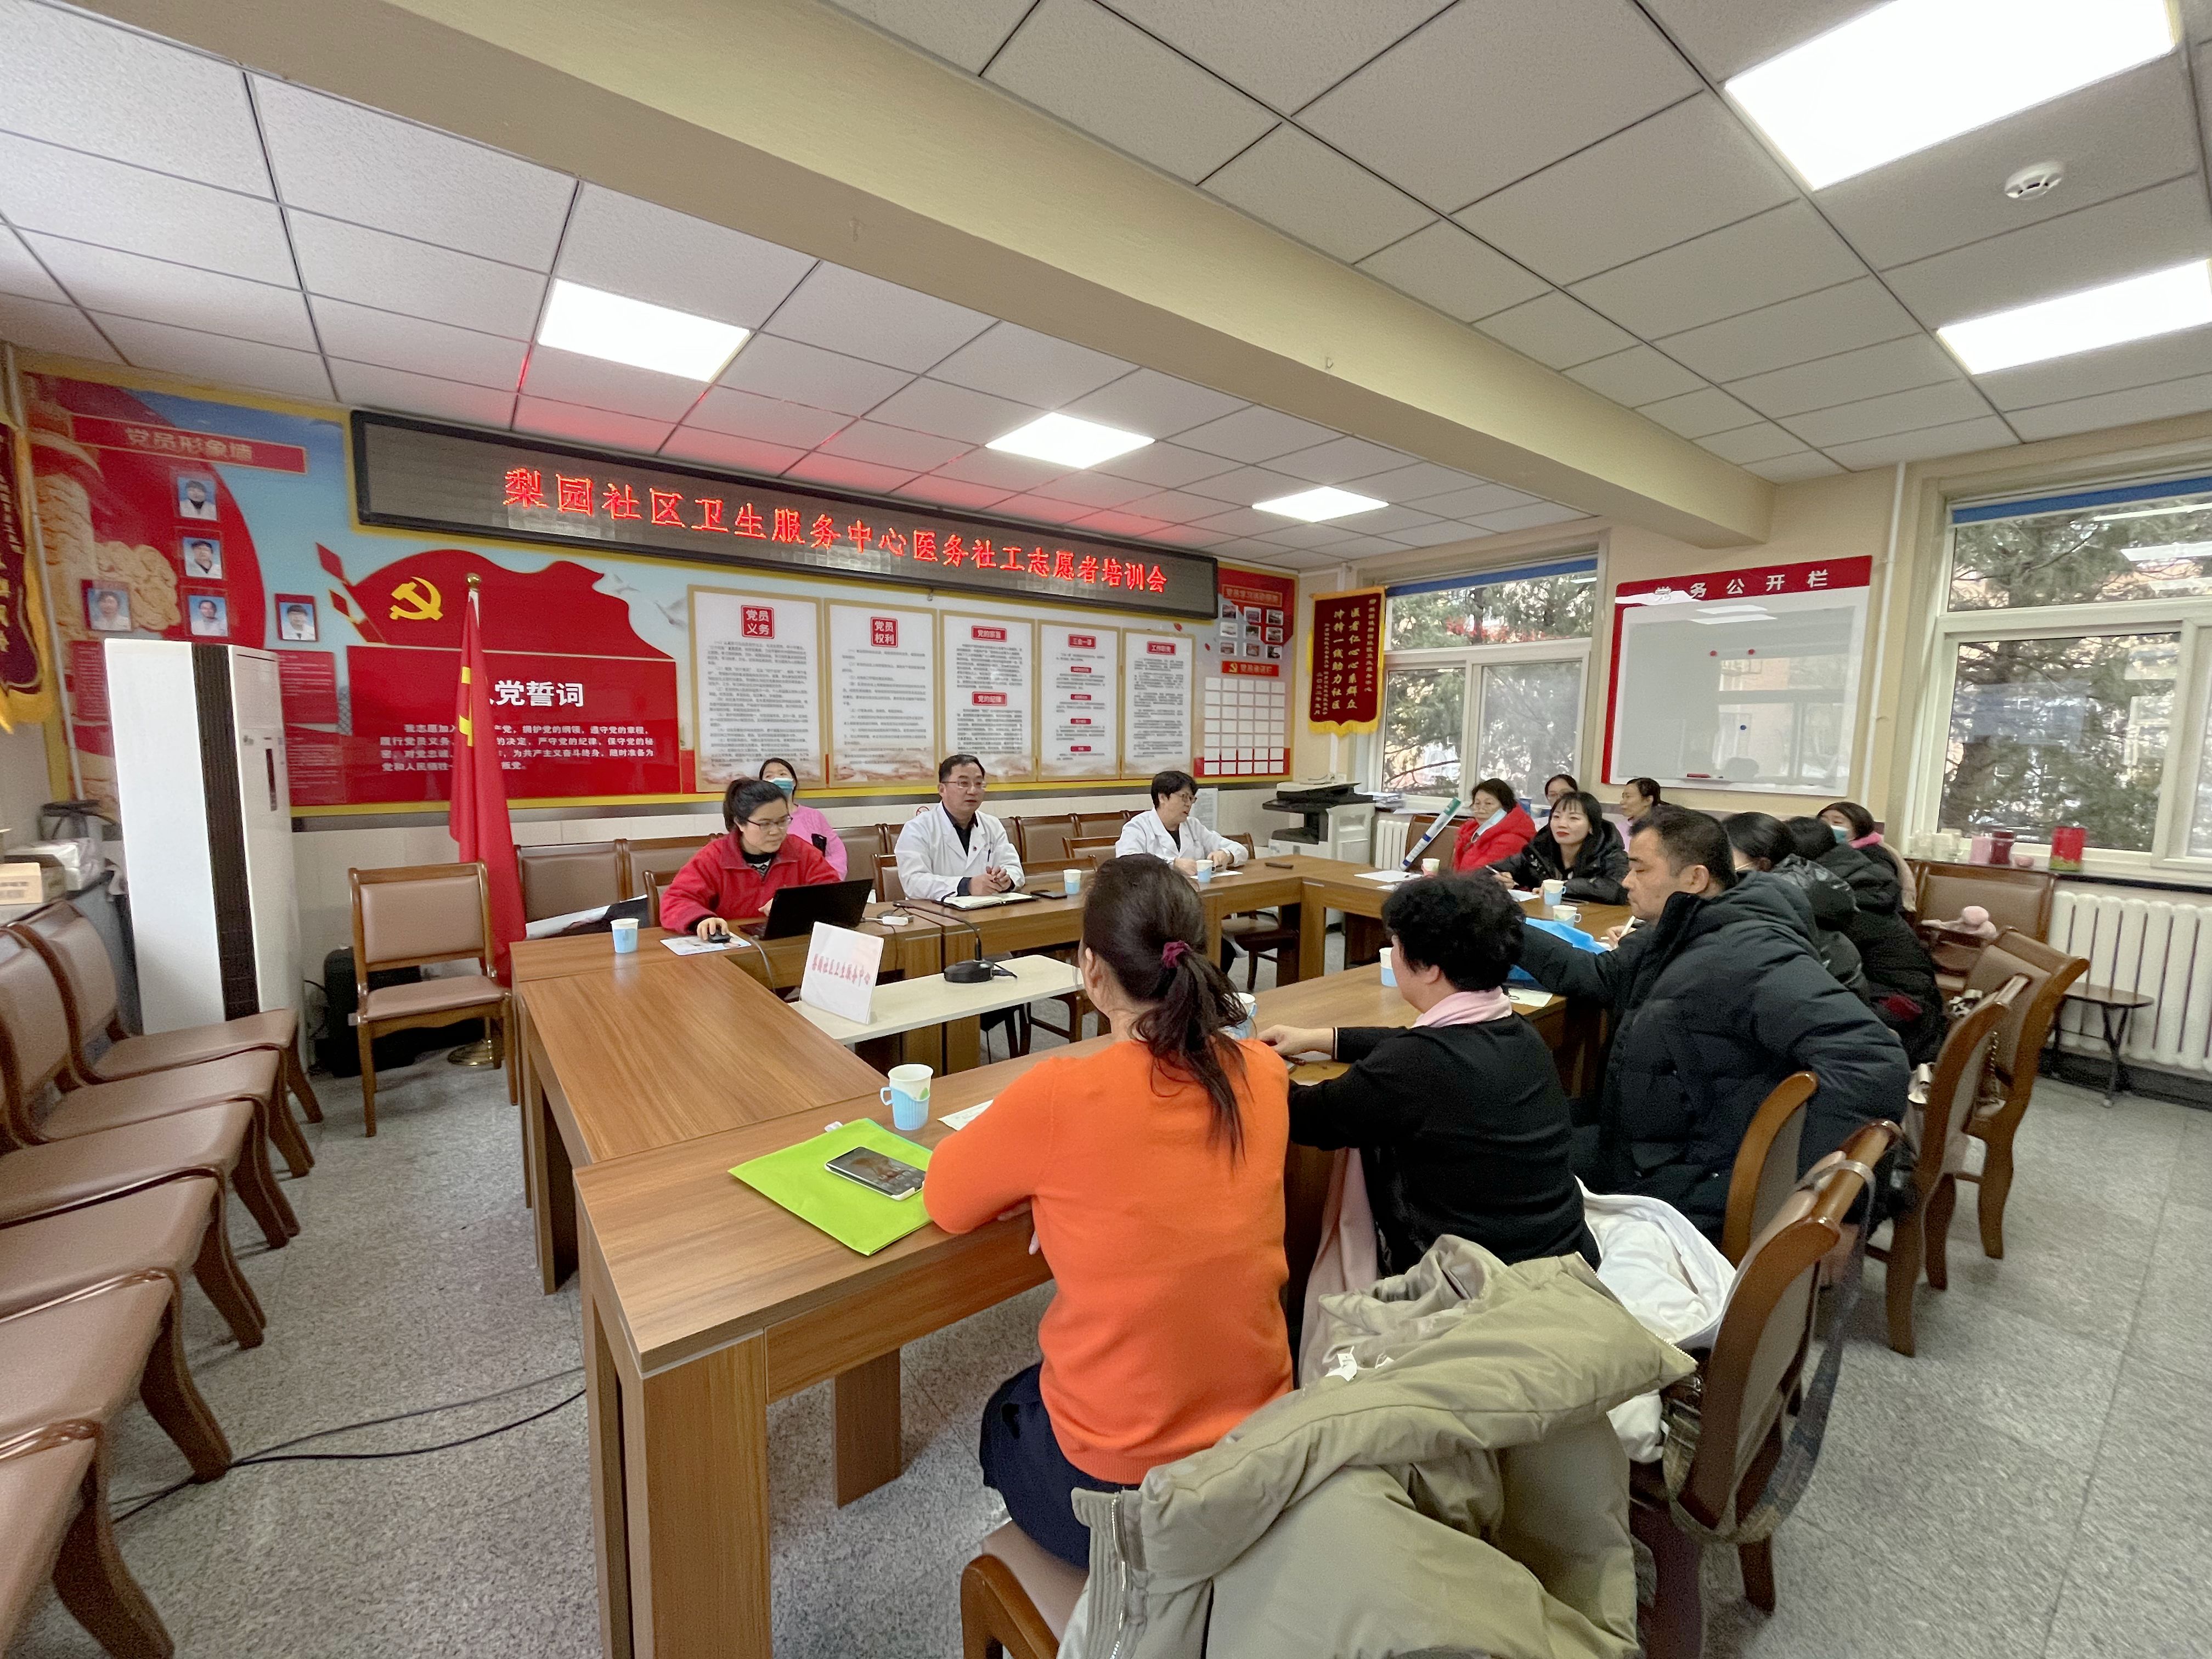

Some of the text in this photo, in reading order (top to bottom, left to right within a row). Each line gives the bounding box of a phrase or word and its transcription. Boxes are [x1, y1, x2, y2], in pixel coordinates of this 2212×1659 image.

[503, 468, 1167, 593] 梨园社区卫生服务中心医务社工志愿者培训会
[1654, 568, 1829, 601] 党务公开栏
[746, 609, 769, 622] 党员
[747, 623, 770, 635] 义务
[874, 620, 894, 632] 党员
[874, 633, 894, 645] 权利
[489, 680, 584, 707] 党誓词
